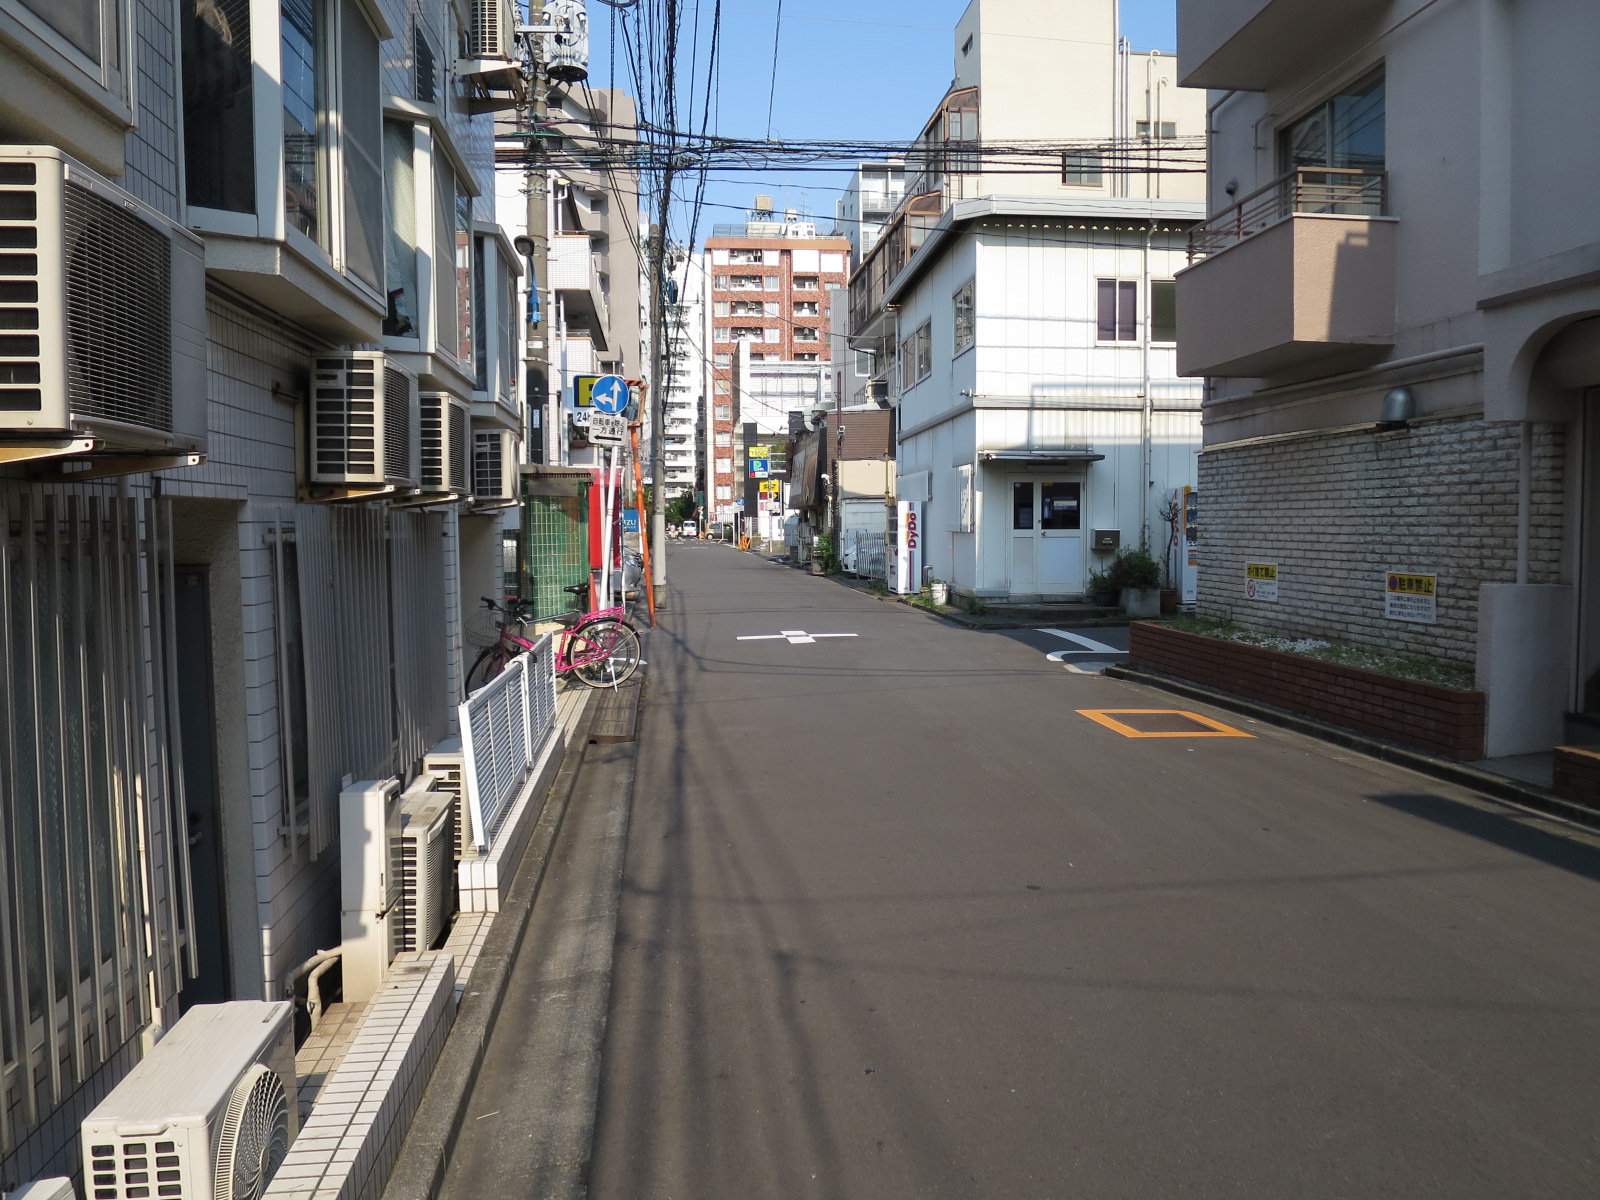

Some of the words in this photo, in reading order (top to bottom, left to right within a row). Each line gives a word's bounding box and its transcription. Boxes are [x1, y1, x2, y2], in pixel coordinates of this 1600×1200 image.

[592, 417, 625, 428] 自転車を除く
[592, 427, 623, 436] 一方通行
[753, 460, 762, 471] P
[908, 512, 919, 548] DyDo
[1247, 566, 1276, 578] ポイ捨て禁止
[1398, 577, 1433, 593] 駐車禁止
